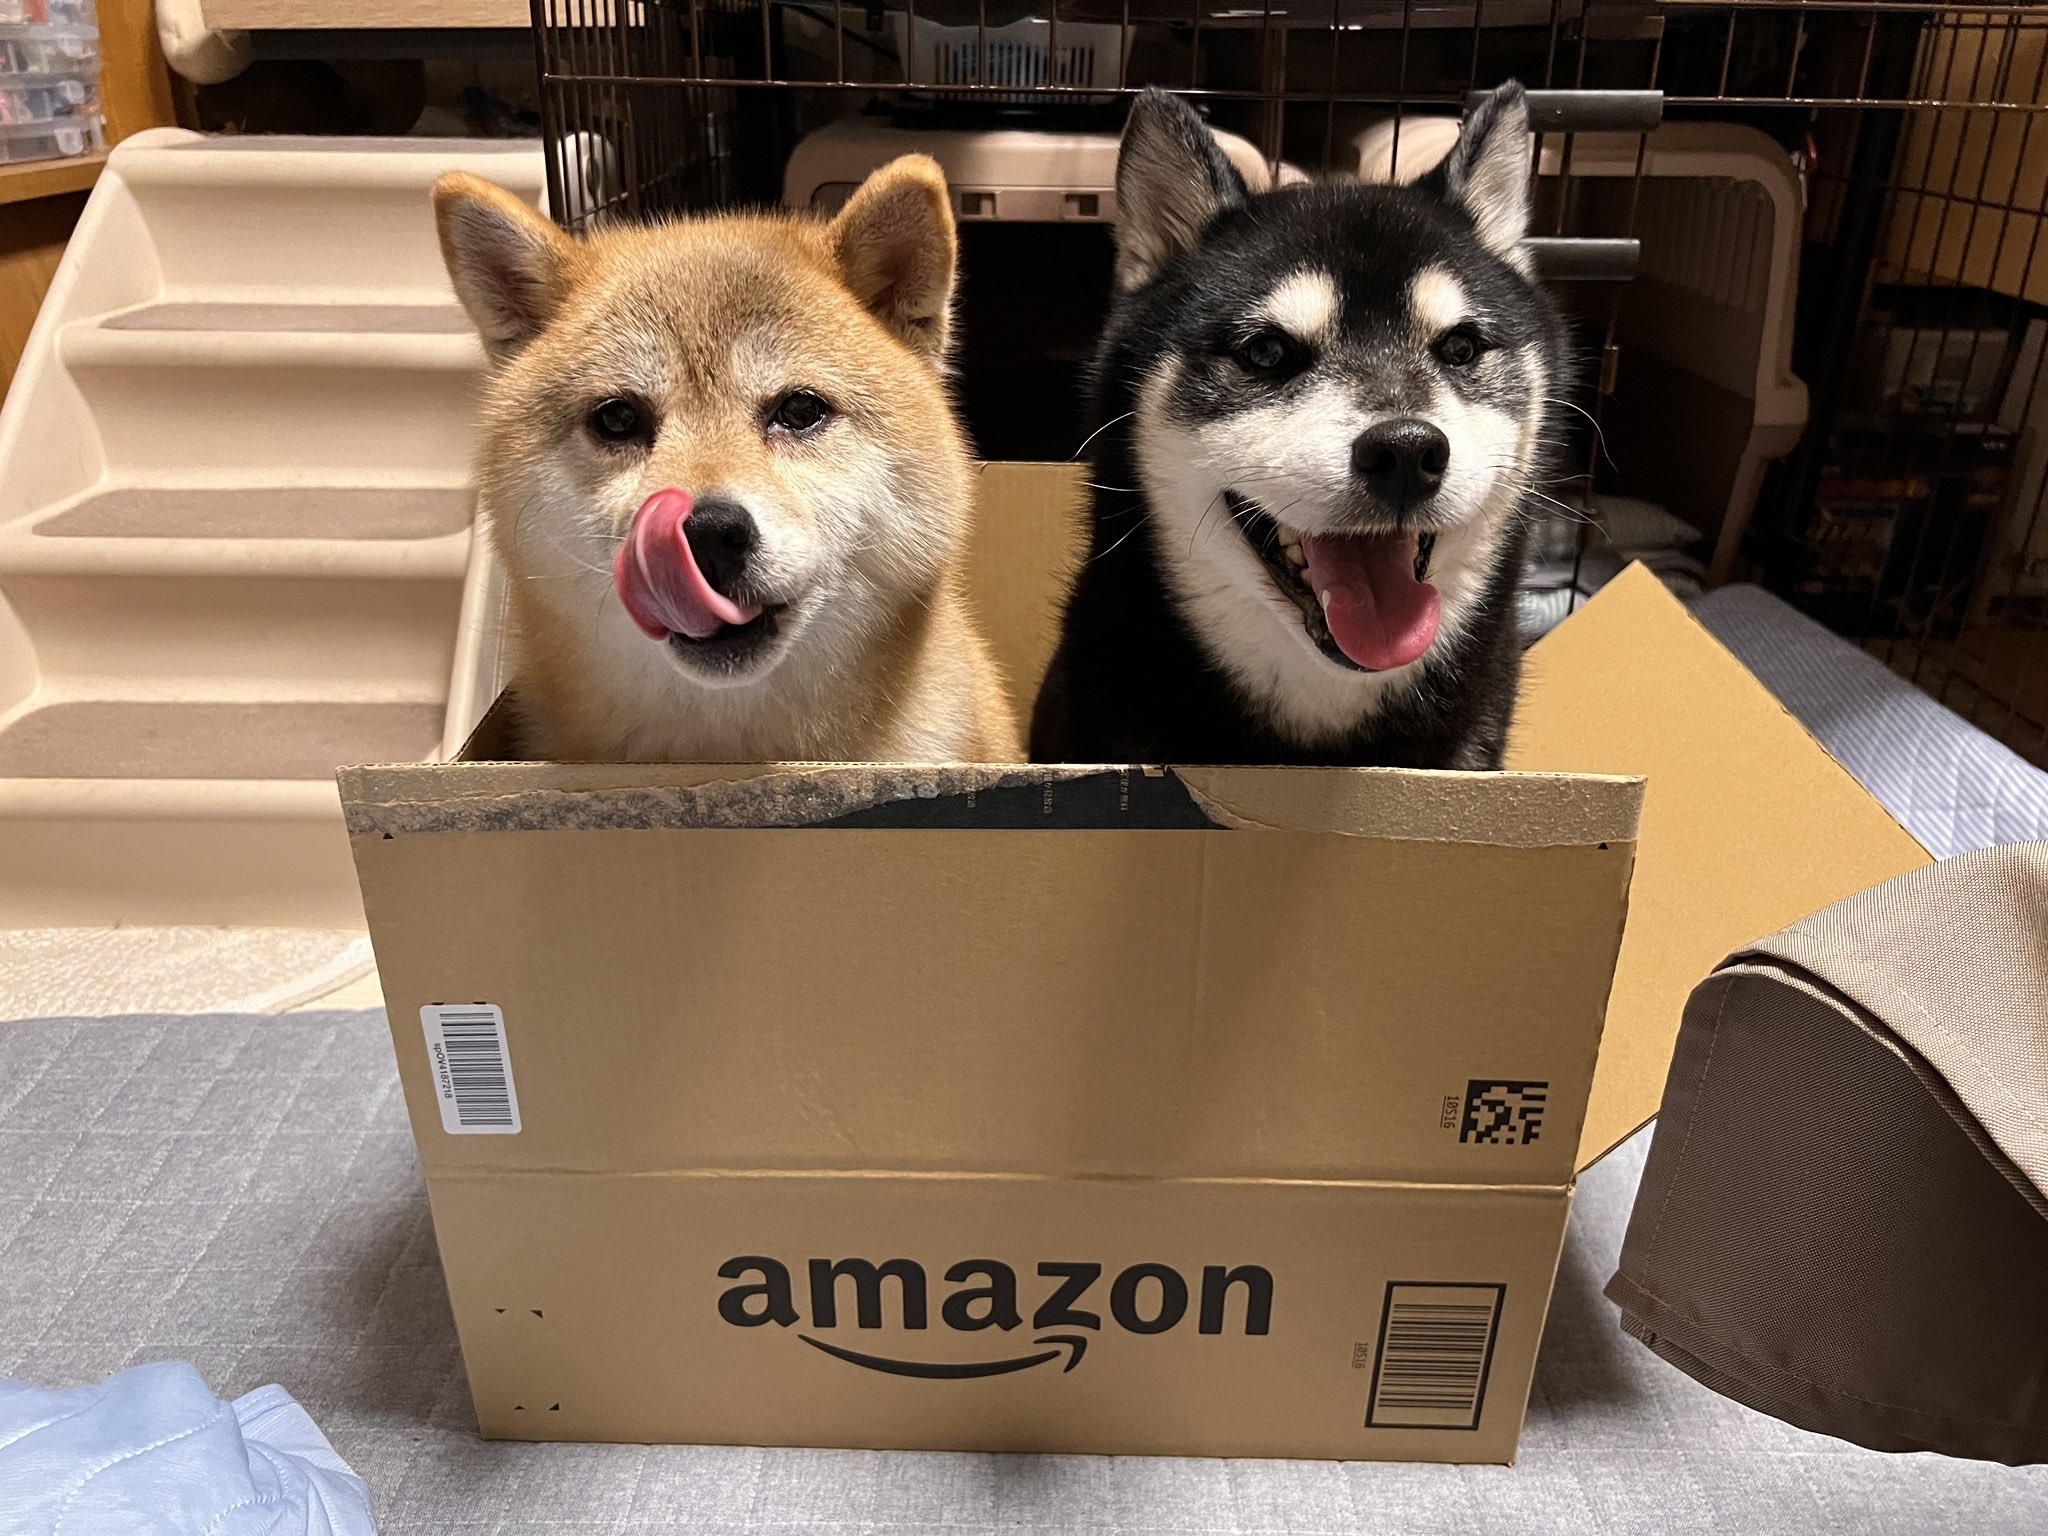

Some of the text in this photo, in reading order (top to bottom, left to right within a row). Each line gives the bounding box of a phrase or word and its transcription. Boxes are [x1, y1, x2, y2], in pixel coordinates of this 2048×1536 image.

[433, 1042, 453, 1099] spOV4187218
[1443, 1096, 1460, 1129] 10S16
[717, 1255, 1273, 1335] amazon
